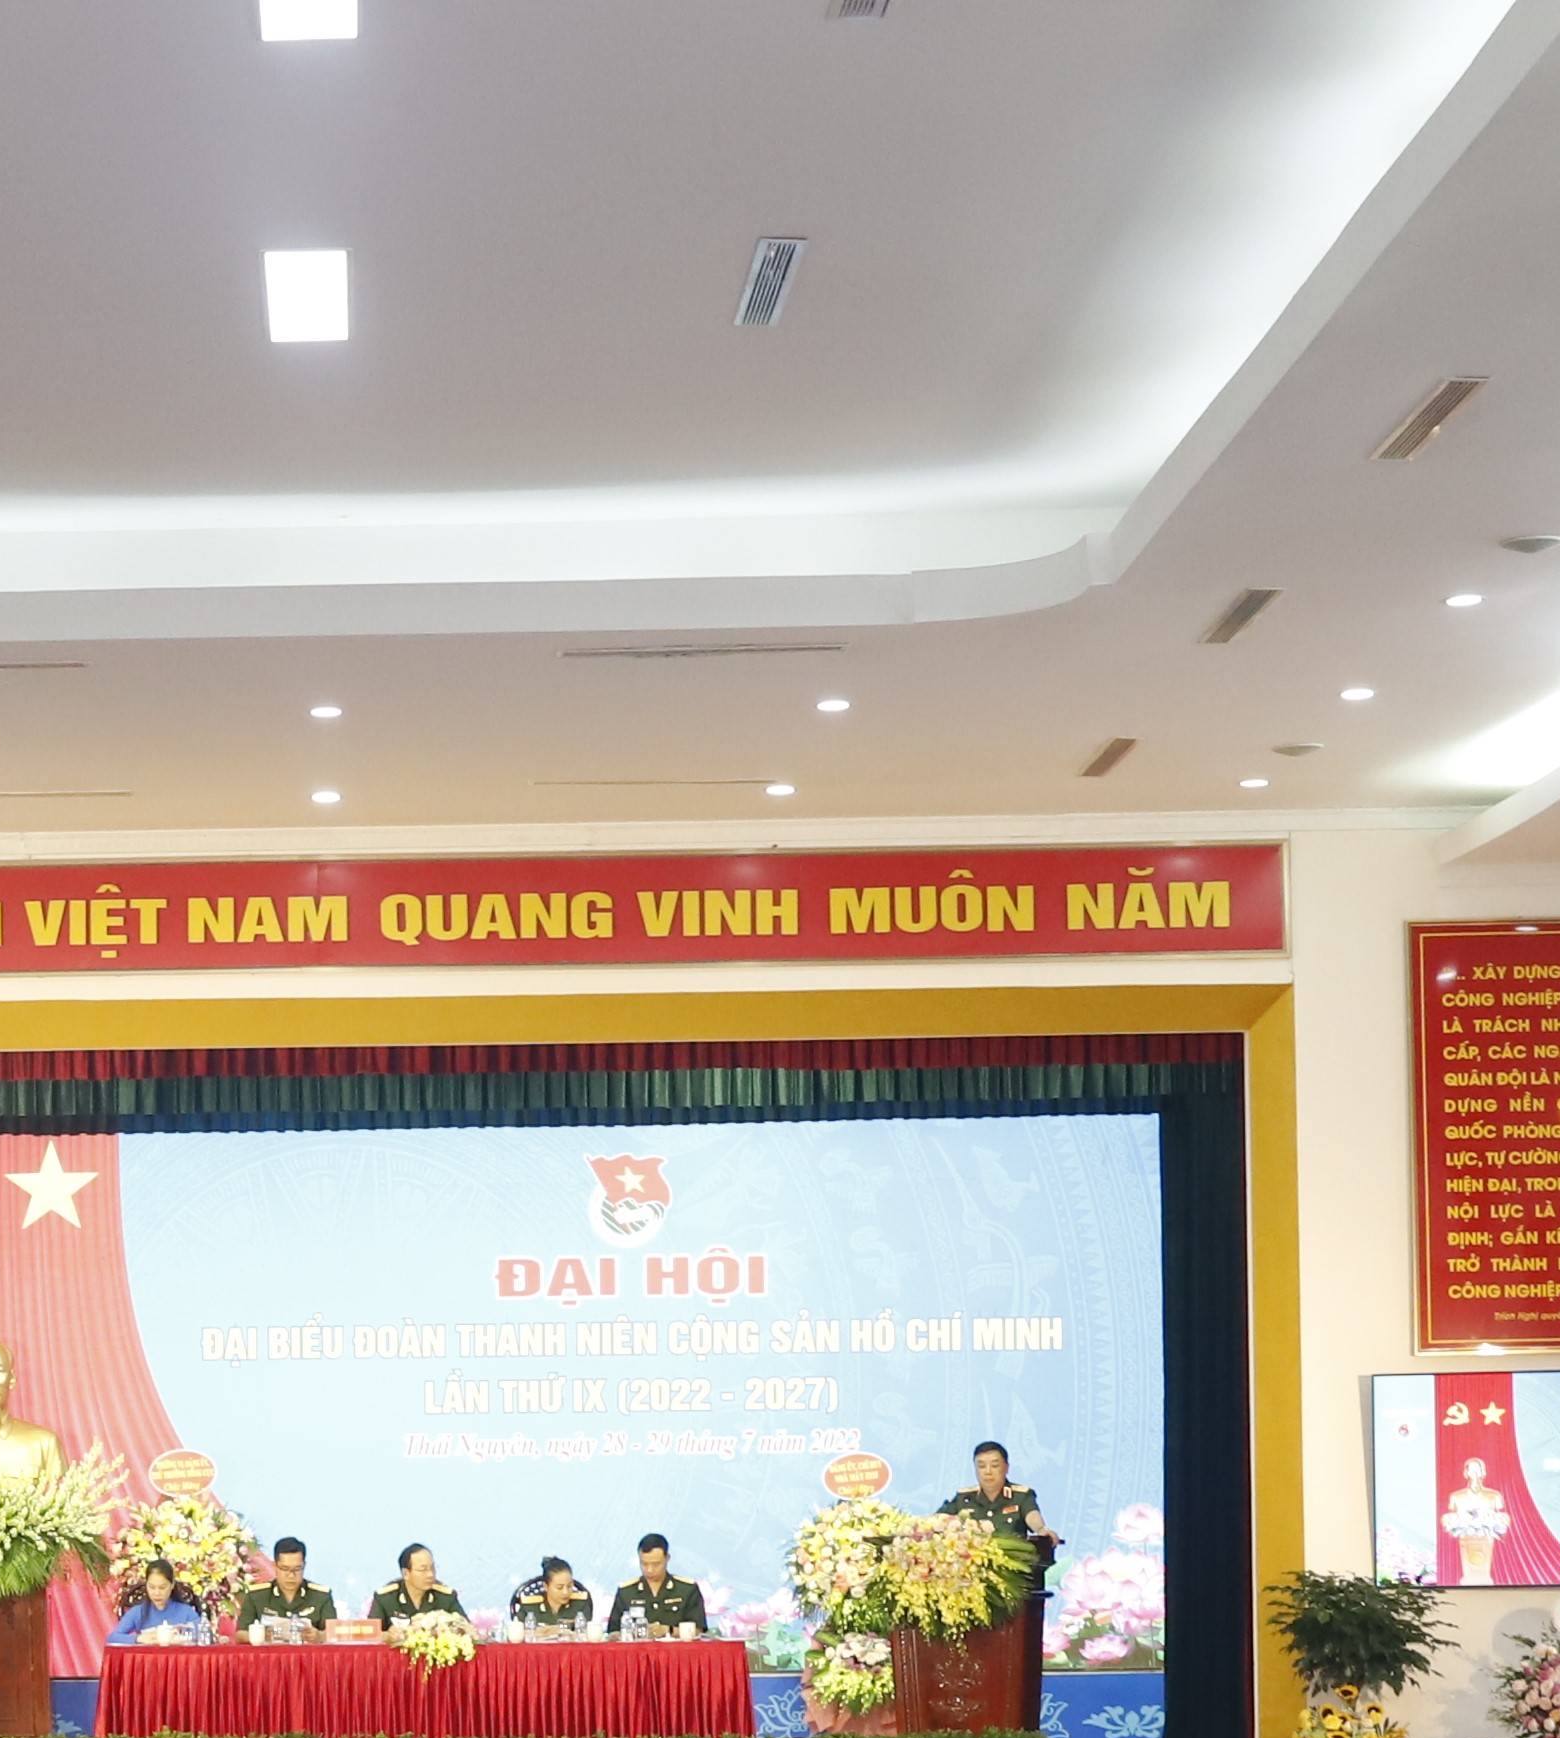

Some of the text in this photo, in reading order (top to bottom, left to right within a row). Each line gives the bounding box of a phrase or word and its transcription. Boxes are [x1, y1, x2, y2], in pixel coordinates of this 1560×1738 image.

[22, 883, 166, 958] VIỆT
[187, 895, 348, 944] NAM
[379, 892, 613, 945] QUANG
[637, 887, 798, 938] VINH
[829, 869, 1033, 935] MUÔN
[1065, 866, 1230, 932] NĂM
[1442, 990, 1495, 1007] CÔNG
[495, 1247, 764, 1305] ĐẠI HỘI
[1447, 1253, 1480, 1272] TRỞ
[1491, 1255, 1548, 1272] THÀNH
[200, 1308, 1062, 1367] ĐẠI BIỂU ĐOÀN THANH NIÊN CỘNG SẢN HỒ CHÍ MINH
[424, 1369, 839, 1415] LẦN THỨ IX (2022 - 2027)
[405, 1434, 452, 1457] Thái
[458, 1434, 539, 1460] Nguyên,
[547, 1438, 595, 1459] ngày
[603, 1432, 626, 1455] 28
[649, 1432, 670, 1453] 29
[677, 1431, 736, 1459] tháng
[744, 1431, 755, 1452] 7
[760, 1433, 804, 1453] năm
[811, 1430, 860, 1451] 2022
